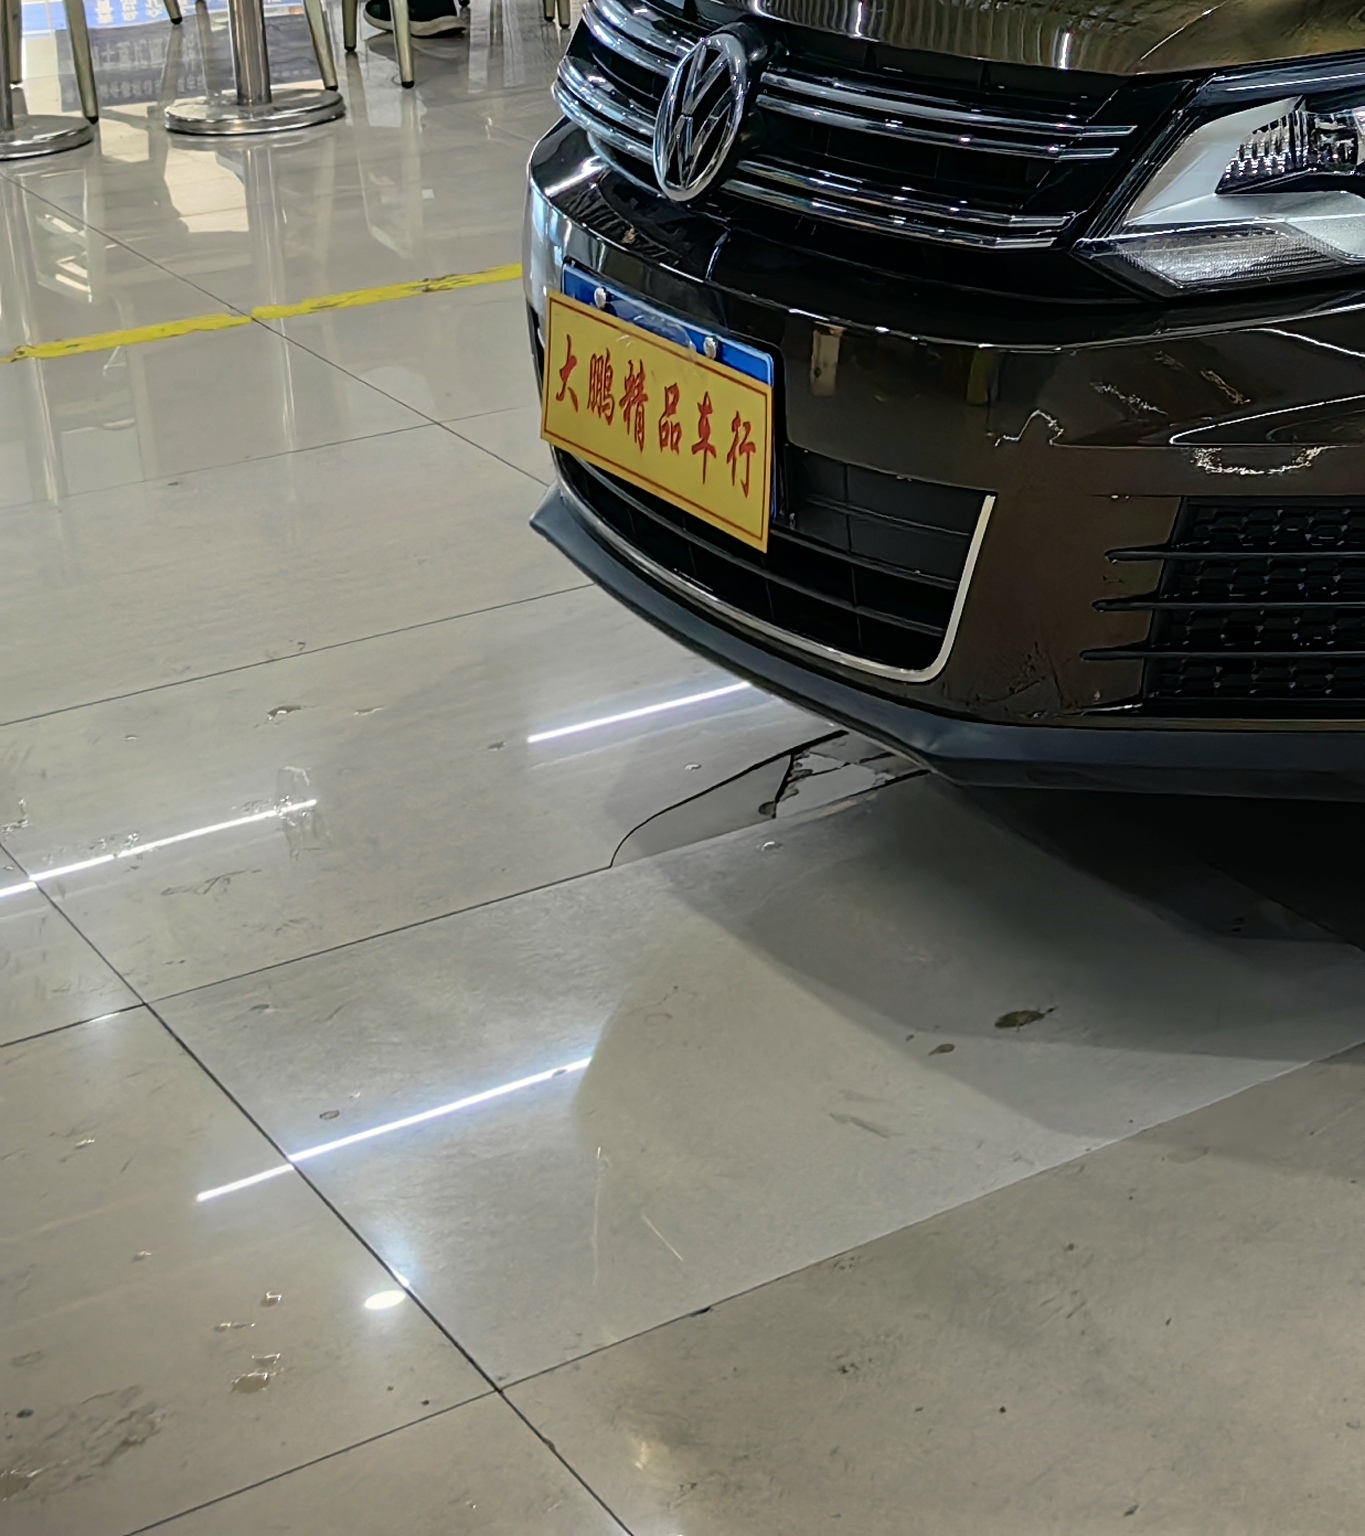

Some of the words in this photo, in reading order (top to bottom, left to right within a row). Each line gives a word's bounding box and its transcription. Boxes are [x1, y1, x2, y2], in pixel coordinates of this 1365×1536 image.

[556, 333, 756, 498] 大鹏精品车行
